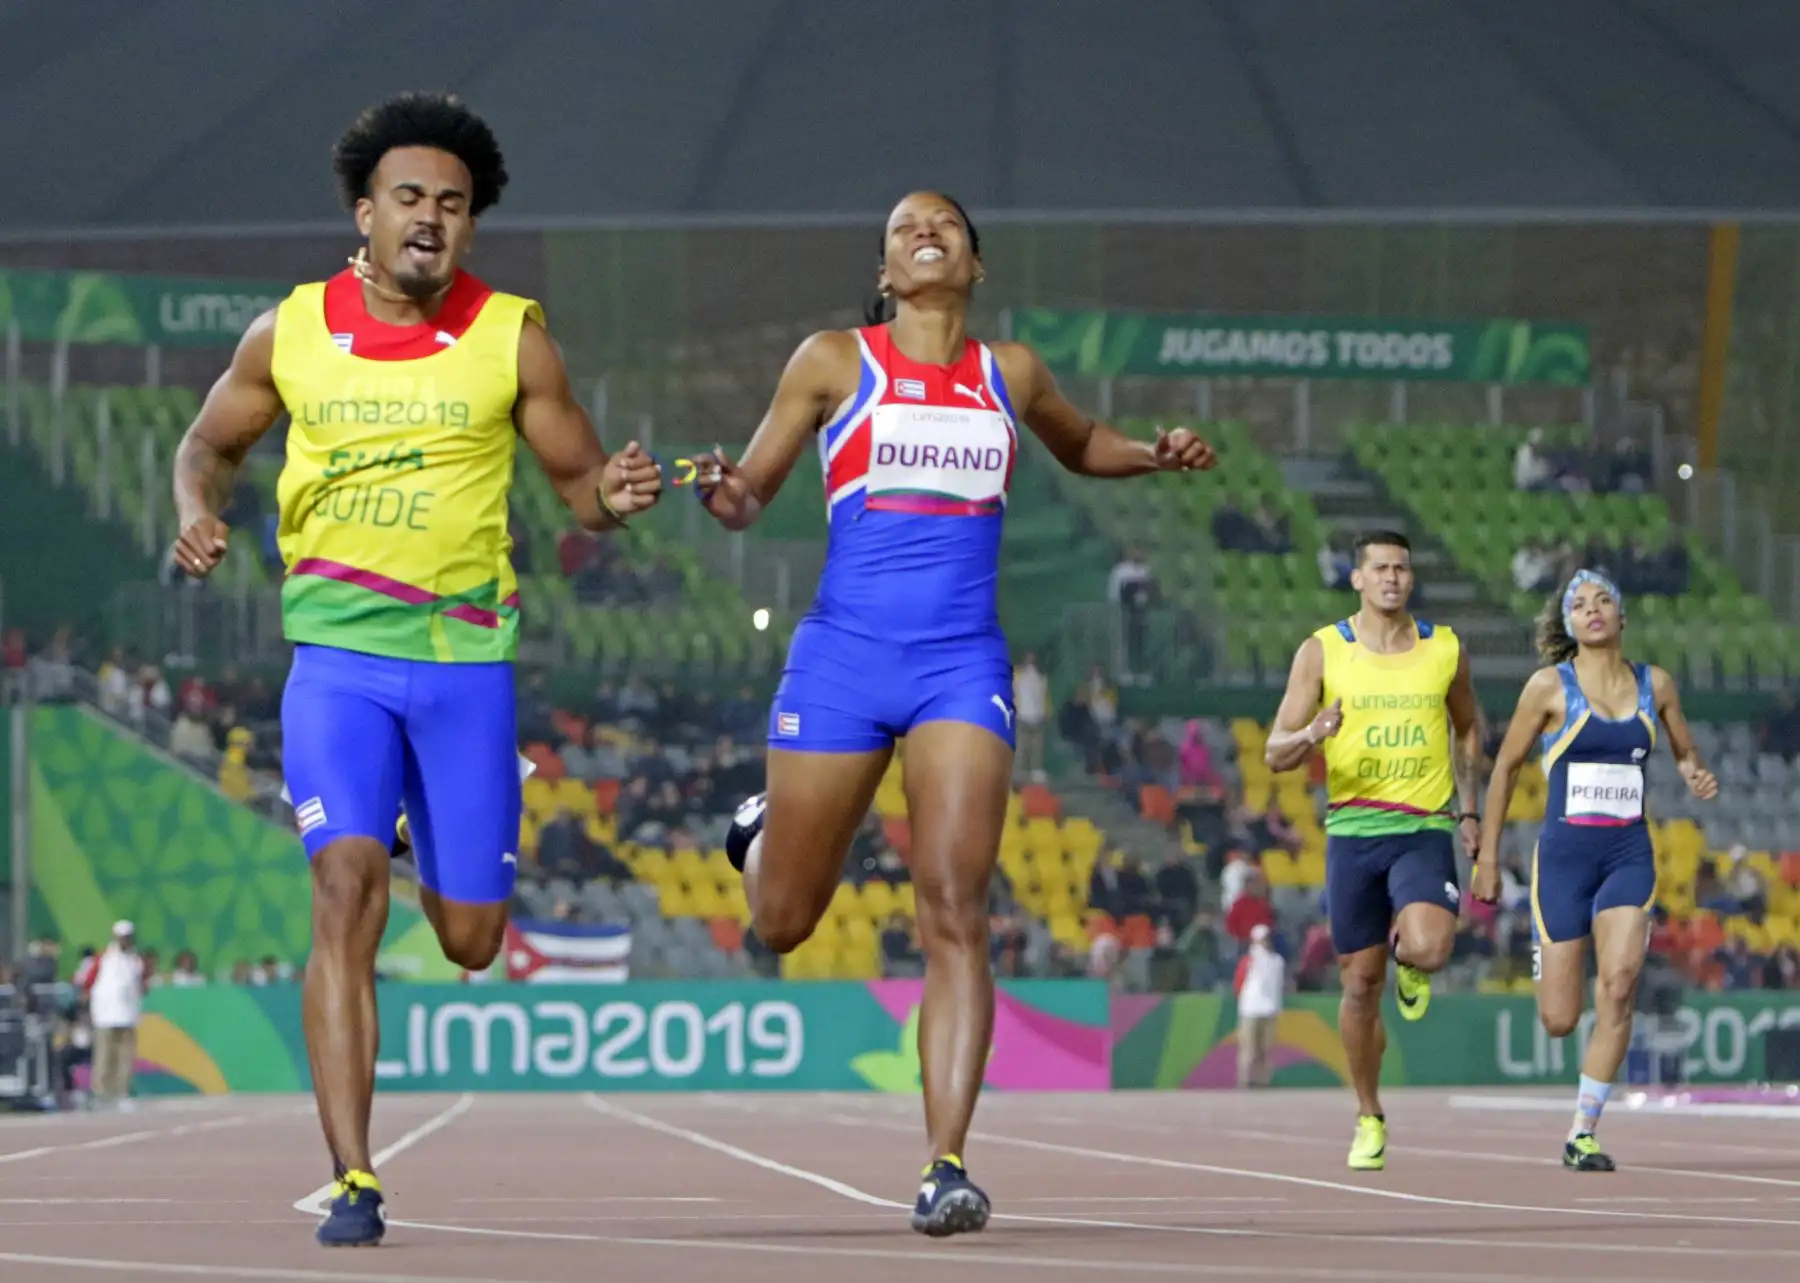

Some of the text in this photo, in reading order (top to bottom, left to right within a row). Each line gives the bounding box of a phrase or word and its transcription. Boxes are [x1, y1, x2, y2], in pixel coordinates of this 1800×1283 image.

[1158, 328, 1454, 369] JUGAMOS TODOS
[876, 443, 1004, 471] DURAND
[1365, 717, 1429, 749] GUÍA
[1357, 756, 1433, 780] GUIDE
[1571, 785, 1640, 802] PEREIRA
[374, 1001, 804, 1077] ima2019
